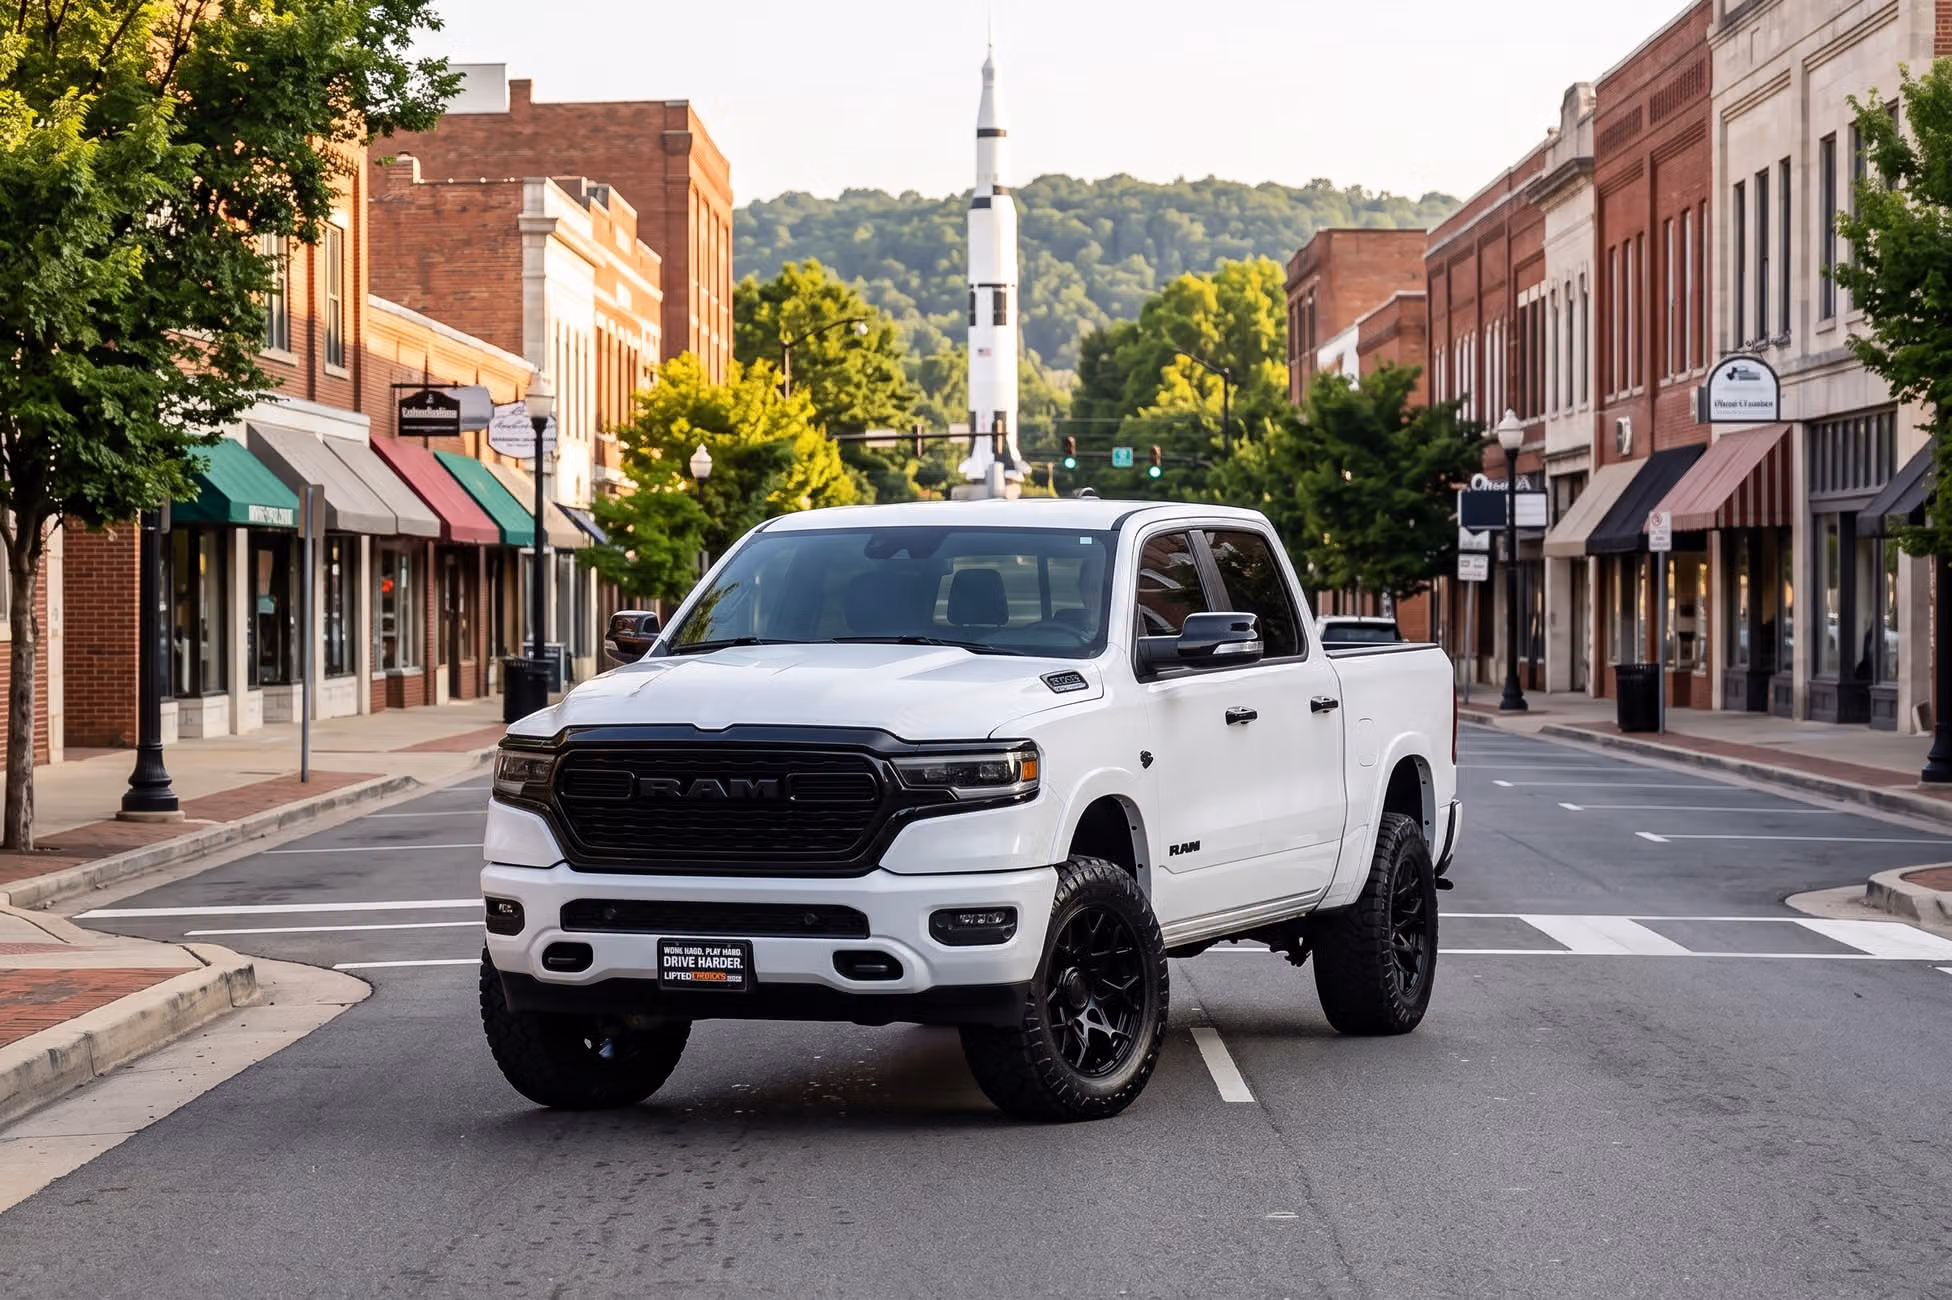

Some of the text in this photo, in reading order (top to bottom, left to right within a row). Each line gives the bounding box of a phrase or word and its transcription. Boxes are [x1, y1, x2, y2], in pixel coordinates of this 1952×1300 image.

[639, 777, 779, 798] RAM
[1169, 840, 1201, 857] RAM
[705, 948, 721, 956] PLAY
[663, 956, 744, 969] DRIVE HARDER.
